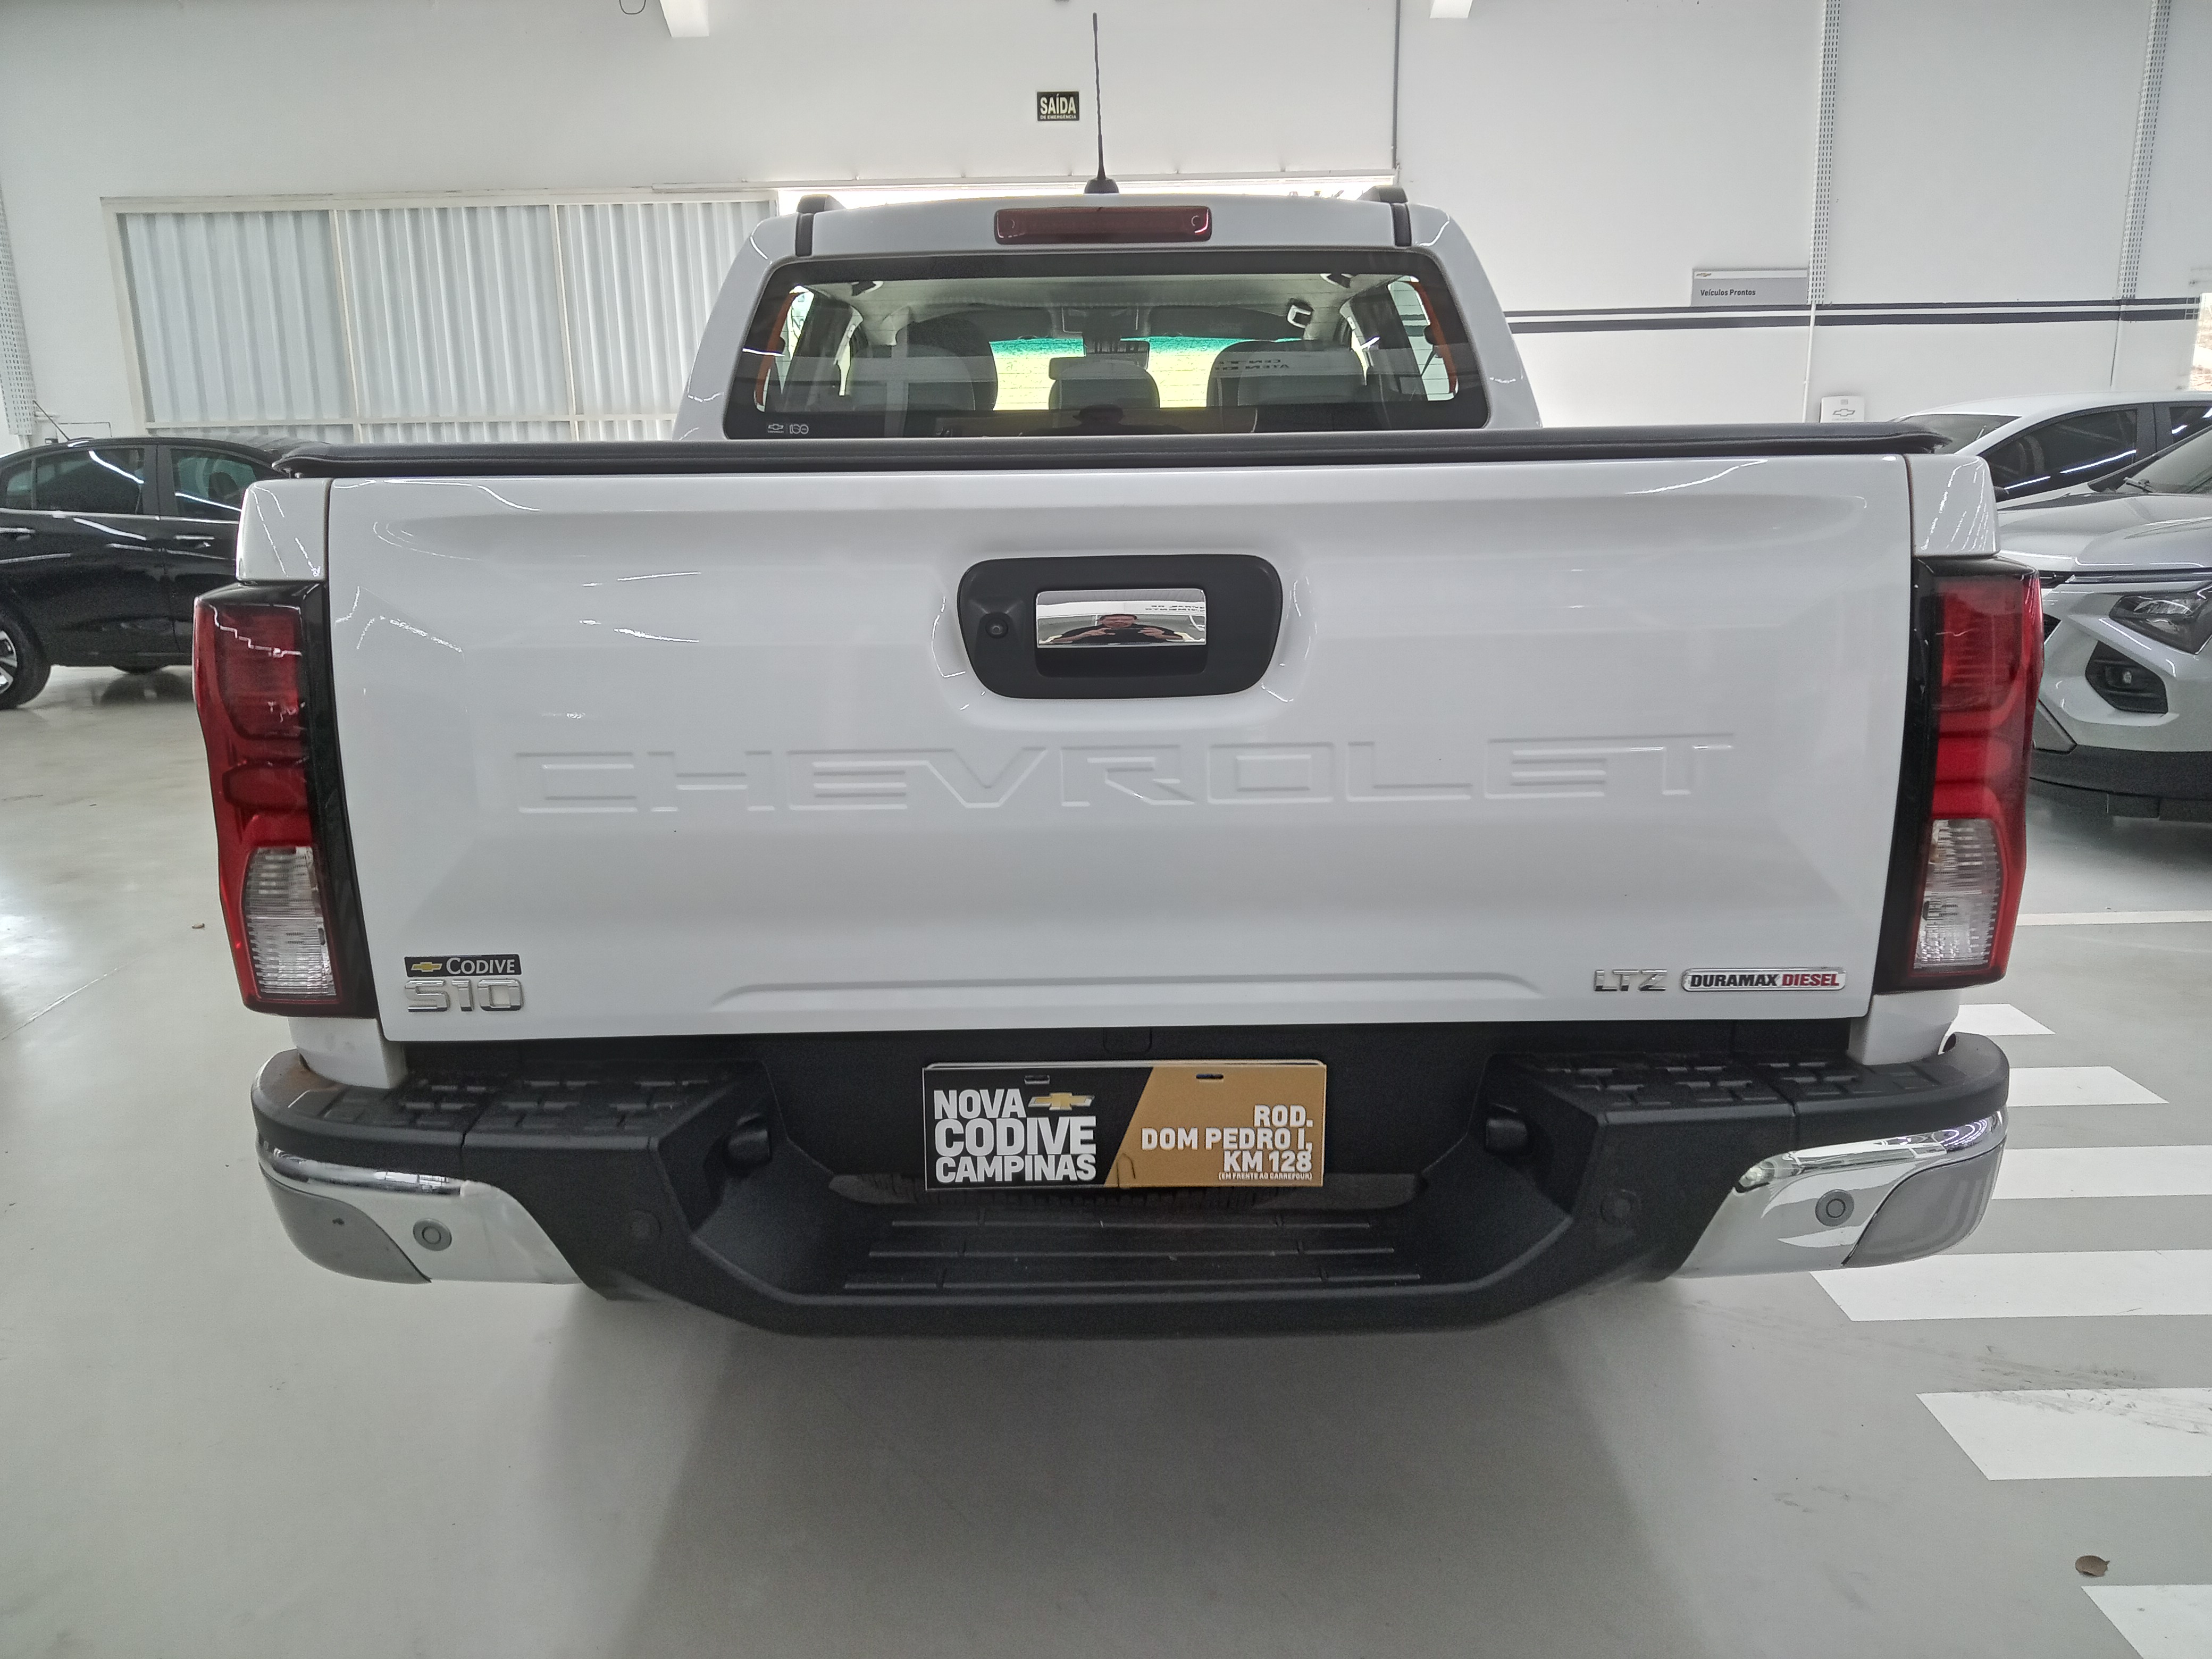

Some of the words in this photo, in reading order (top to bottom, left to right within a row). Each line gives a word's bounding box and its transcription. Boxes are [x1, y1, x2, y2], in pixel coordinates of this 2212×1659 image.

[1040, 94, 1076, 114] SAÍDA
[516, 732, 1735, 817] CHEVROLET
[1594, 969, 1668, 992] LTZ
[1690, 974, 1779, 987] DURAMAX
[1781, 974, 1840, 986] DIESEL
[405, 979, 524, 1011] S10
[934, 1088, 1027, 1119] NOVA
[1254, 1104, 1313, 1127] ROD.
[935, 1116, 1096, 1157] CODIVE
[1141, 1127, 1198, 1150] DOM
[1205, 1127, 1291, 1150] PEDRO
[936, 1154, 1096, 1183] CAMPINAS
[1224, 1150, 1263, 1172] KM
[1269, 1150, 1312, 1172] 128
